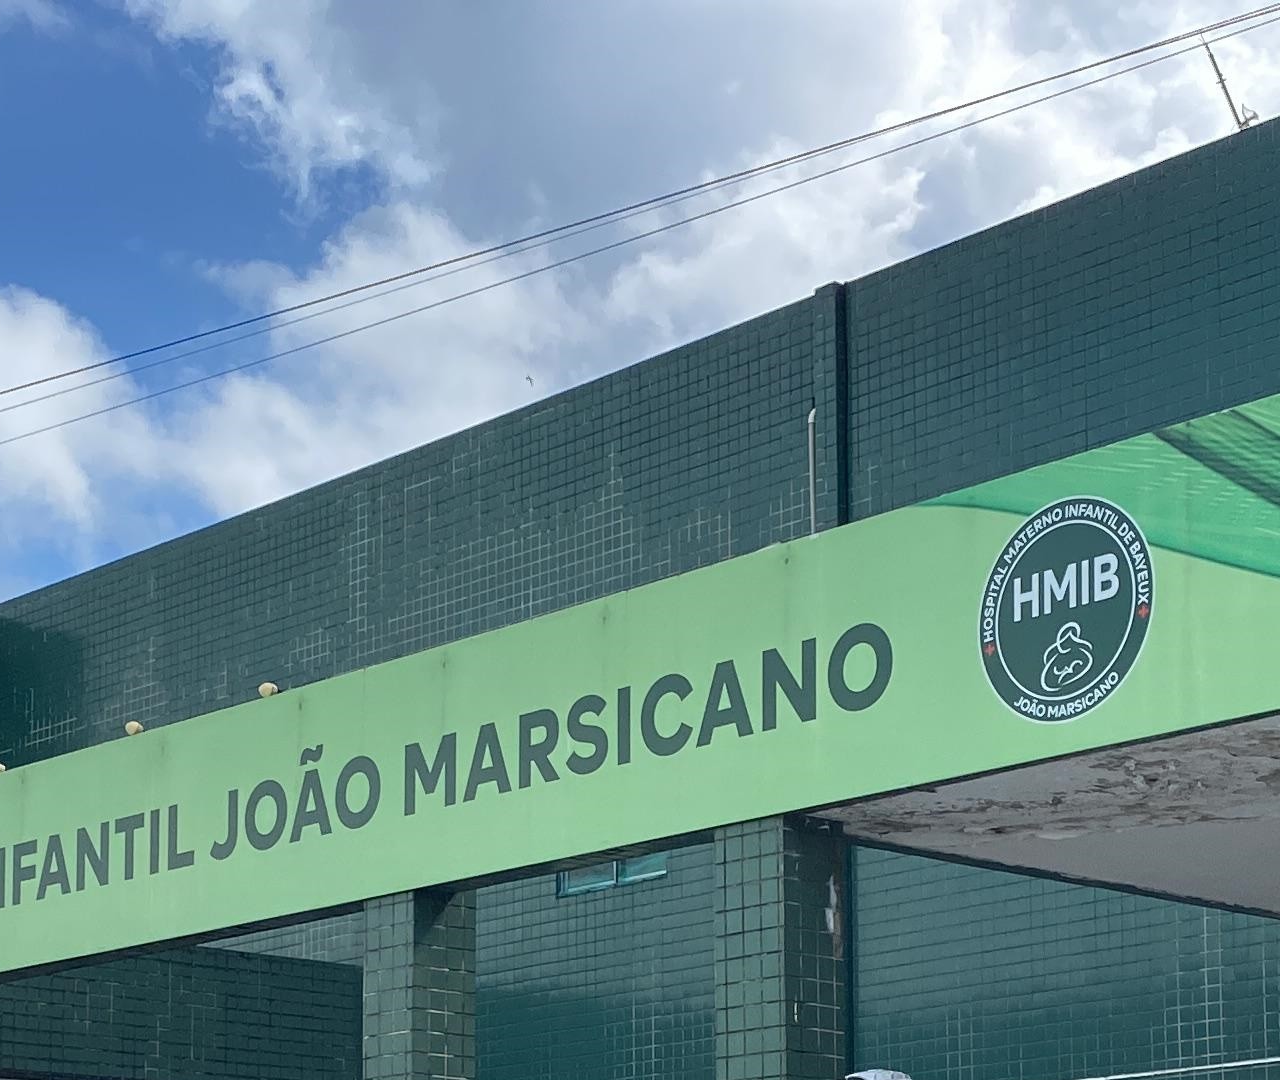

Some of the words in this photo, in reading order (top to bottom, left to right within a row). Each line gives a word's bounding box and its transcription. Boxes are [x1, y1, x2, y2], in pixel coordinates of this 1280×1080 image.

[982, 562, 1010, 644] HOSPITAL
[1003, 507, 1063, 565] MATERNO
[1064, 503, 1120, 531] INFANTIL
[1117, 521, 1137, 545] DE
[1128, 541, 1151, 605] BAYEUX
[1012, 552, 1121, 623] HMIB
[209, 742, 382, 862] JOÃO
[402, 621, 895, 817] MARSICANO
[1013, 696, 1047, 718] JOÃO
[1046, 671, 1120, 719] MARSICANO
